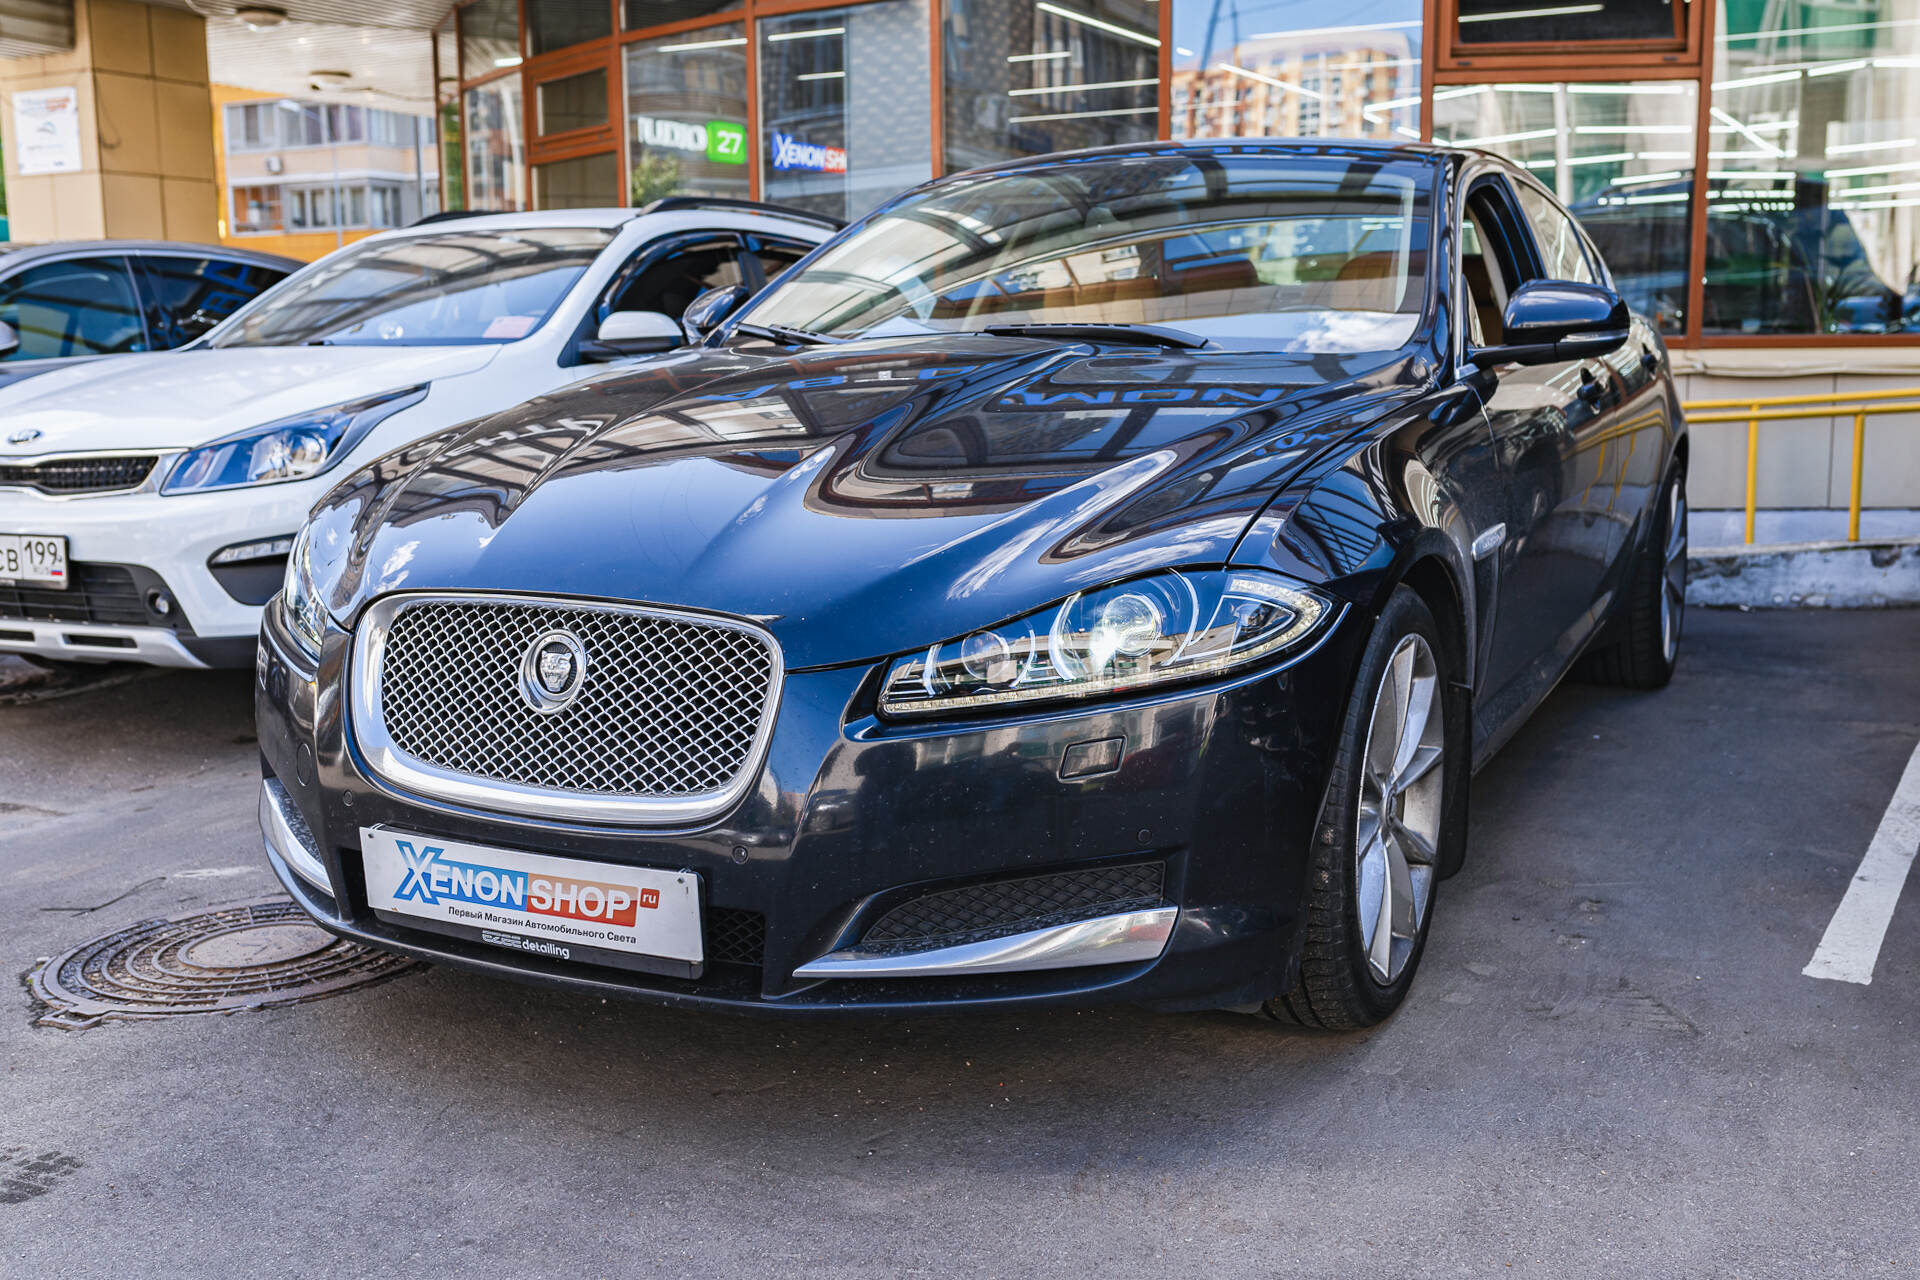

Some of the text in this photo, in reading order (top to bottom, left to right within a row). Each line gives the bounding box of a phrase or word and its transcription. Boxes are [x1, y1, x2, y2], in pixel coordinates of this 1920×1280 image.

[717, 131, 742, 154] 27
[24, 541, 57, 565] 199
[448, 906, 483, 920] Первый
[484, 913, 524, 927] Магазин
[525, 920, 605, 940] Автомобильного
[606, 931, 637, 944] Света
[521, 939, 570, 960] detailing
